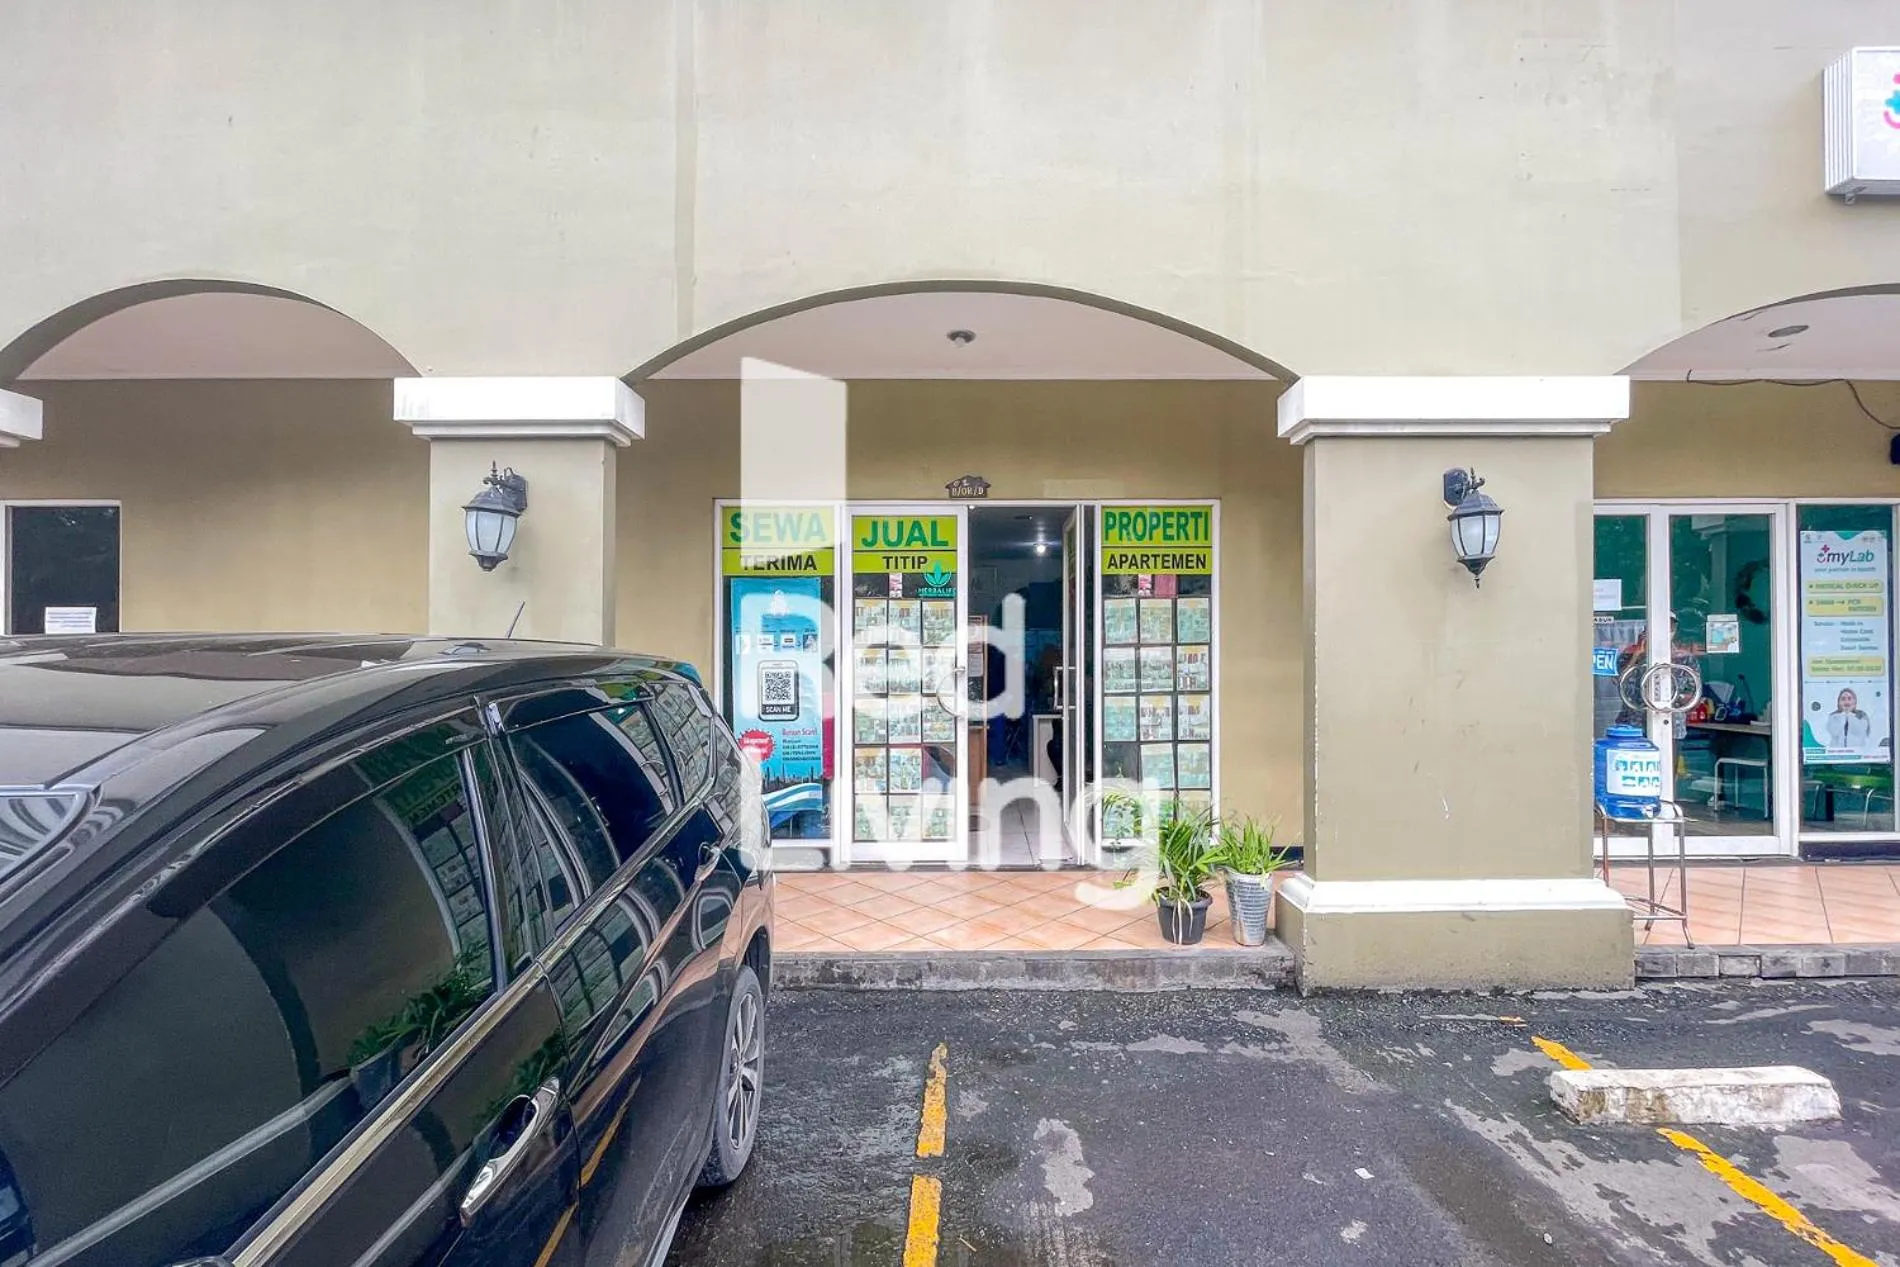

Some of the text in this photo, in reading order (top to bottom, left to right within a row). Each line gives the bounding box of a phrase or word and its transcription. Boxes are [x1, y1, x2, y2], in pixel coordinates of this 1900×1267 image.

[729, 512, 826, 543] SEWA
[861, 520, 949, 547] JUAL
[1104, 511, 1209, 542] PROPERTI
[741, 554, 817, 571] TERIMA
[882, 555, 928, 570] TITIP
[1107, 553, 1206, 570] APARTEMEN
[1827, 550, 1875, 565] myLab
[766, 705, 791, 713] SCAN ME
